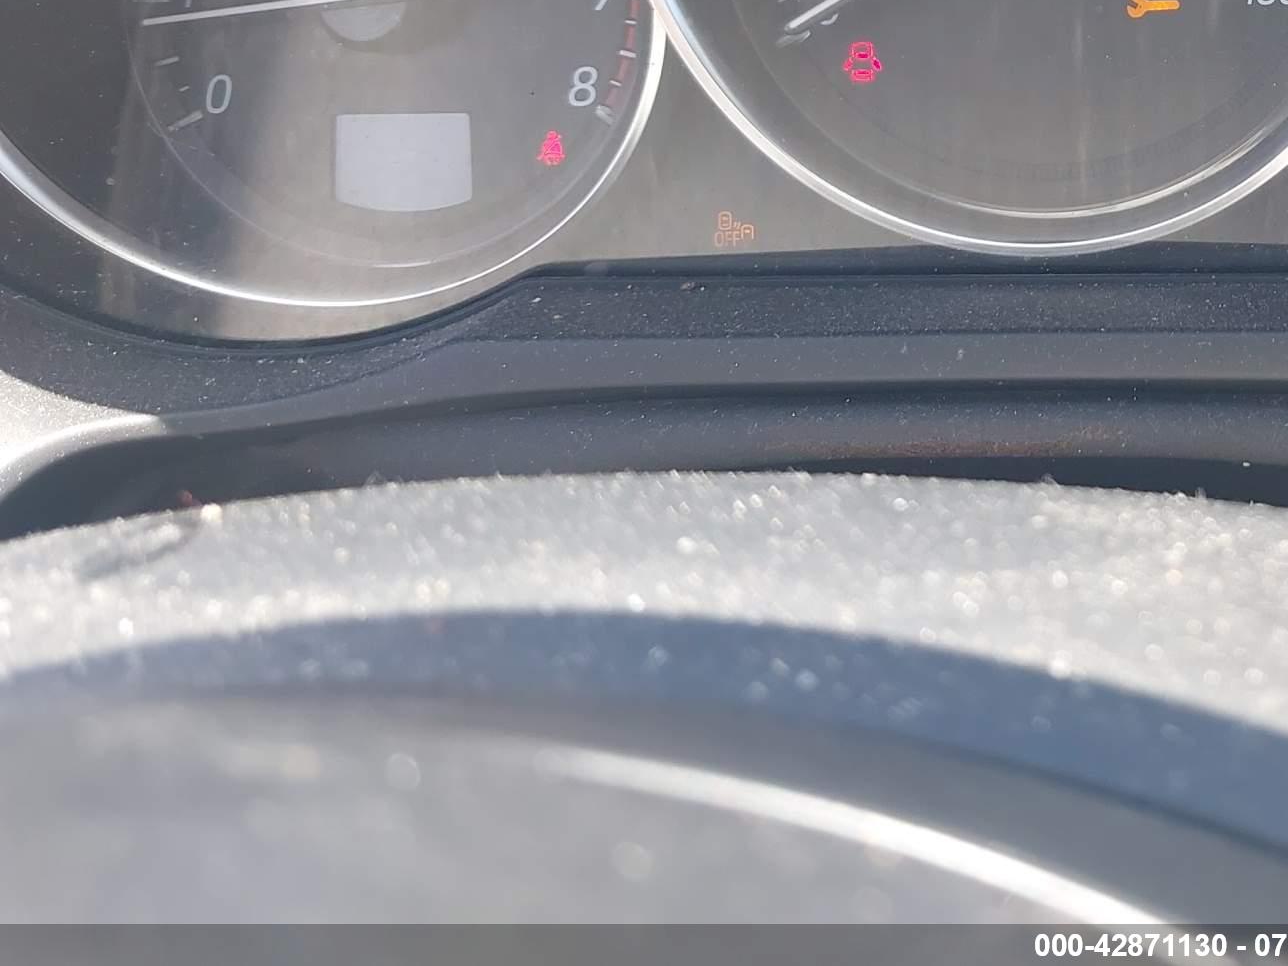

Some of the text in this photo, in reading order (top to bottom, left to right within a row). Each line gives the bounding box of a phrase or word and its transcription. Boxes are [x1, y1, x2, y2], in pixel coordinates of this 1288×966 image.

[205, 74, 232, 114] 0
[568, 65, 599, 107] 8
[714, 230, 741, 247] OFF
